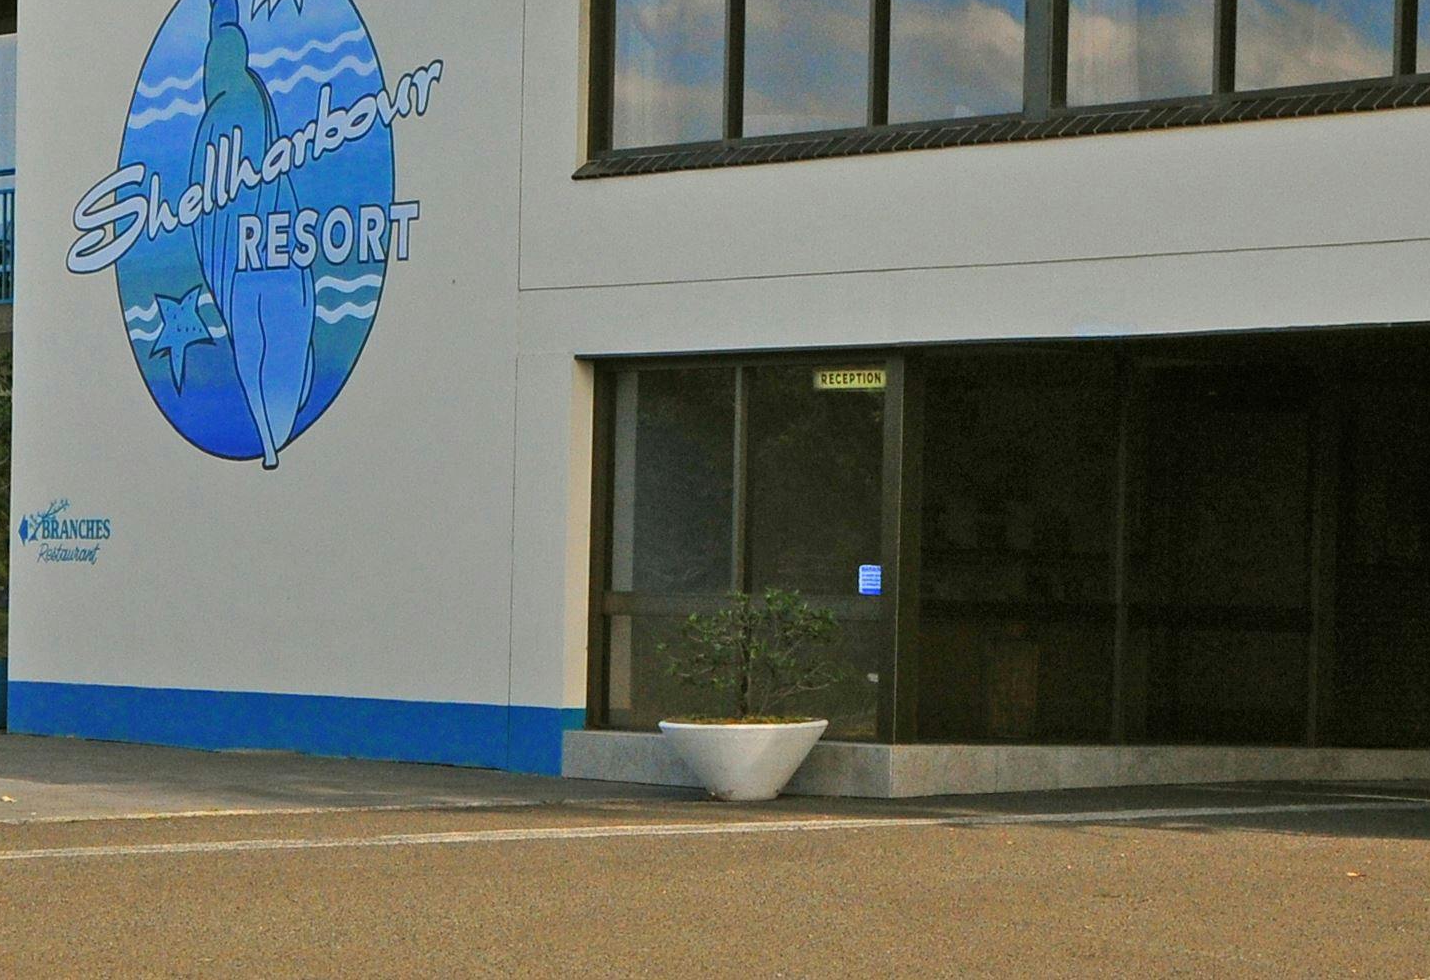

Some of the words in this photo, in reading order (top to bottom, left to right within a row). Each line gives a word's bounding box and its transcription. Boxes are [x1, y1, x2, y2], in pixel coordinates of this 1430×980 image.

[66, 59, 444, 274] Shellharbour
[235, 200, 420, 273] RESORT
[820, 372, 882, 385] RECEPTION
[41, 518, 111, 540] BRANCHES
[36, 542, 100, 565] Restaurant
